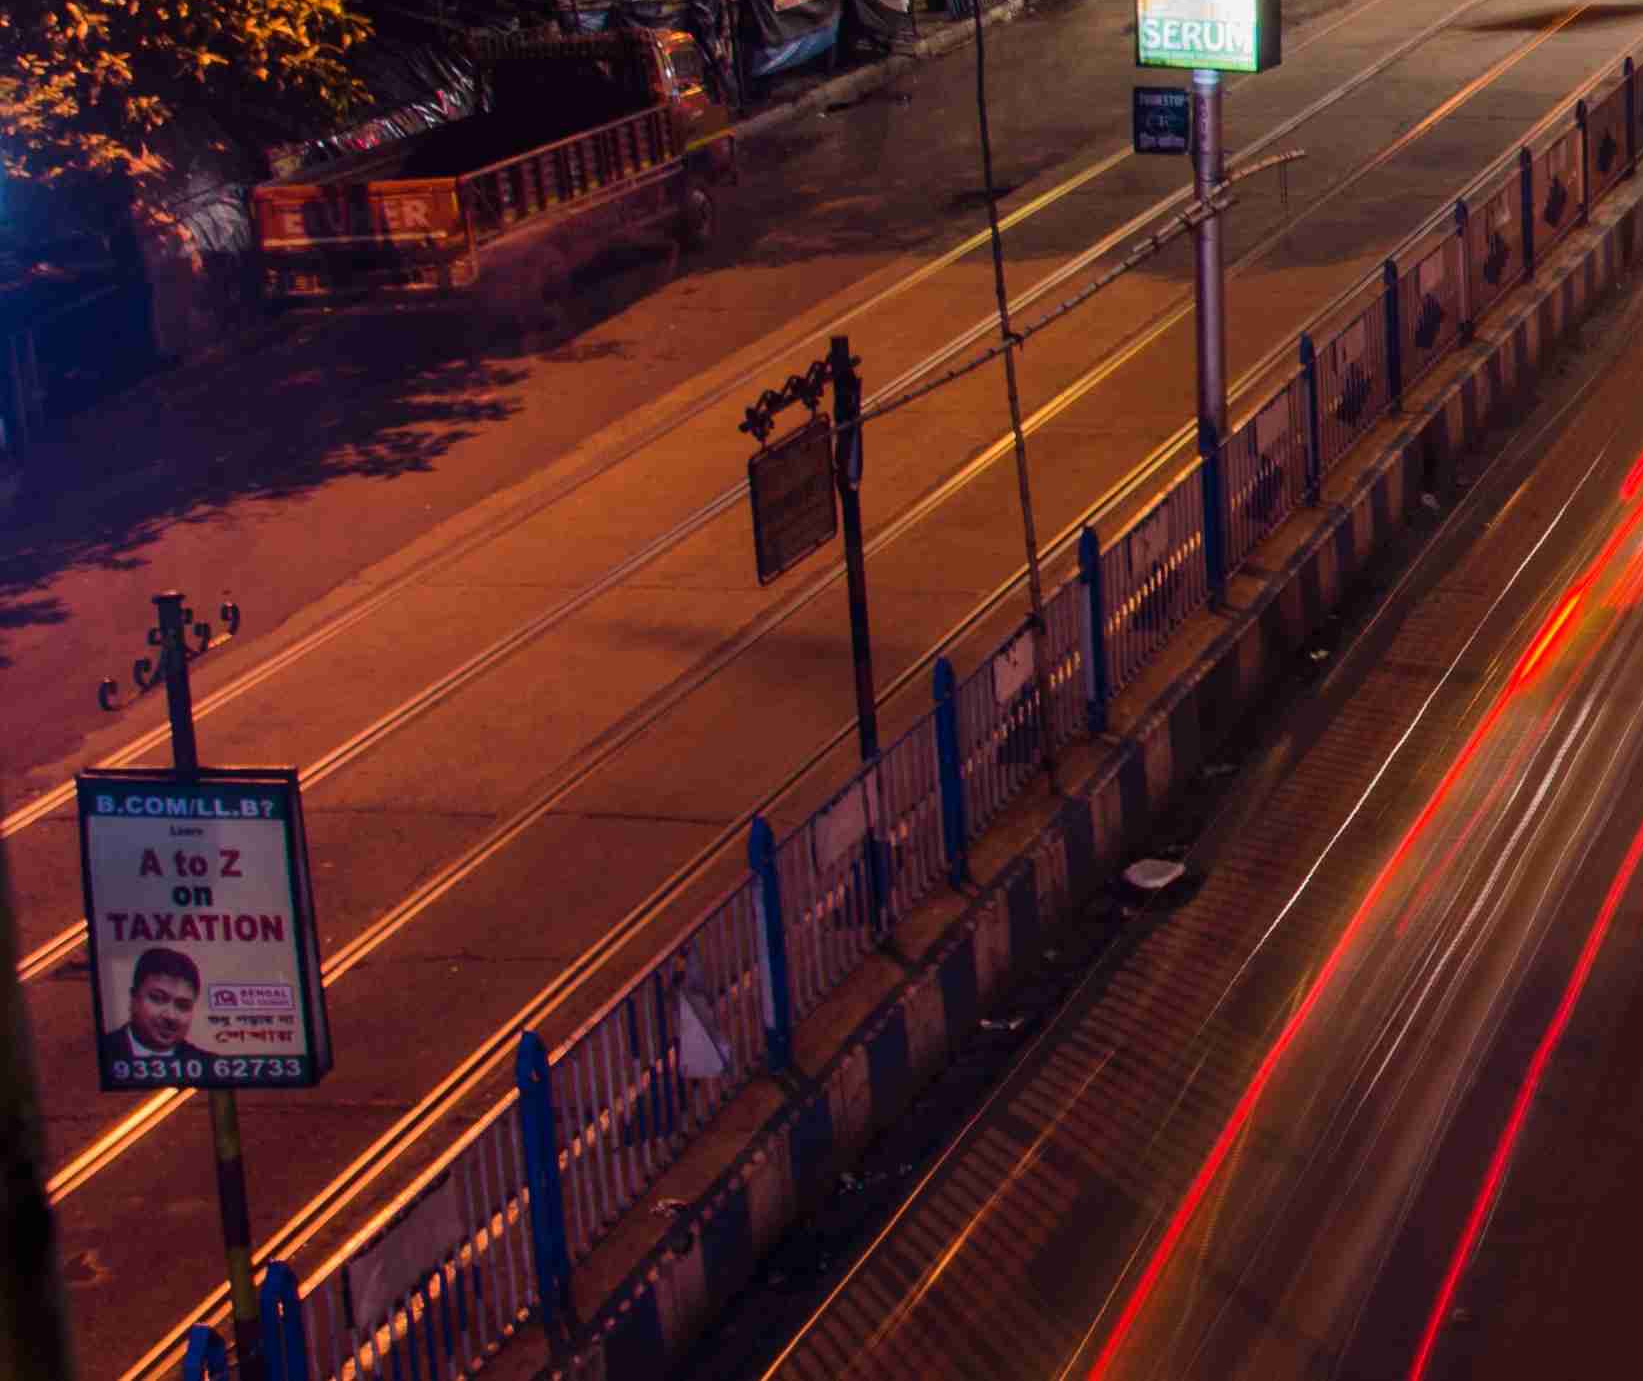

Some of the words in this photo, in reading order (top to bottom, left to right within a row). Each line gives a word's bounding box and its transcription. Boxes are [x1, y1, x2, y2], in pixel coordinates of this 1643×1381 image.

[1142, 20, 1252, 53] SERUM
[96, 795, 275, 817] B.COM/LL.B?
[139, 848, 163, 876] A
[173, 849, 208, 877] to
[219, 849, 242, 877] Z
[172, 884, 213, 906] on
[106, 913, 285, 942] TAXATION
[112, 1059, 203, 1079] 93310
[213, 1058, 302, 1078] 62733
